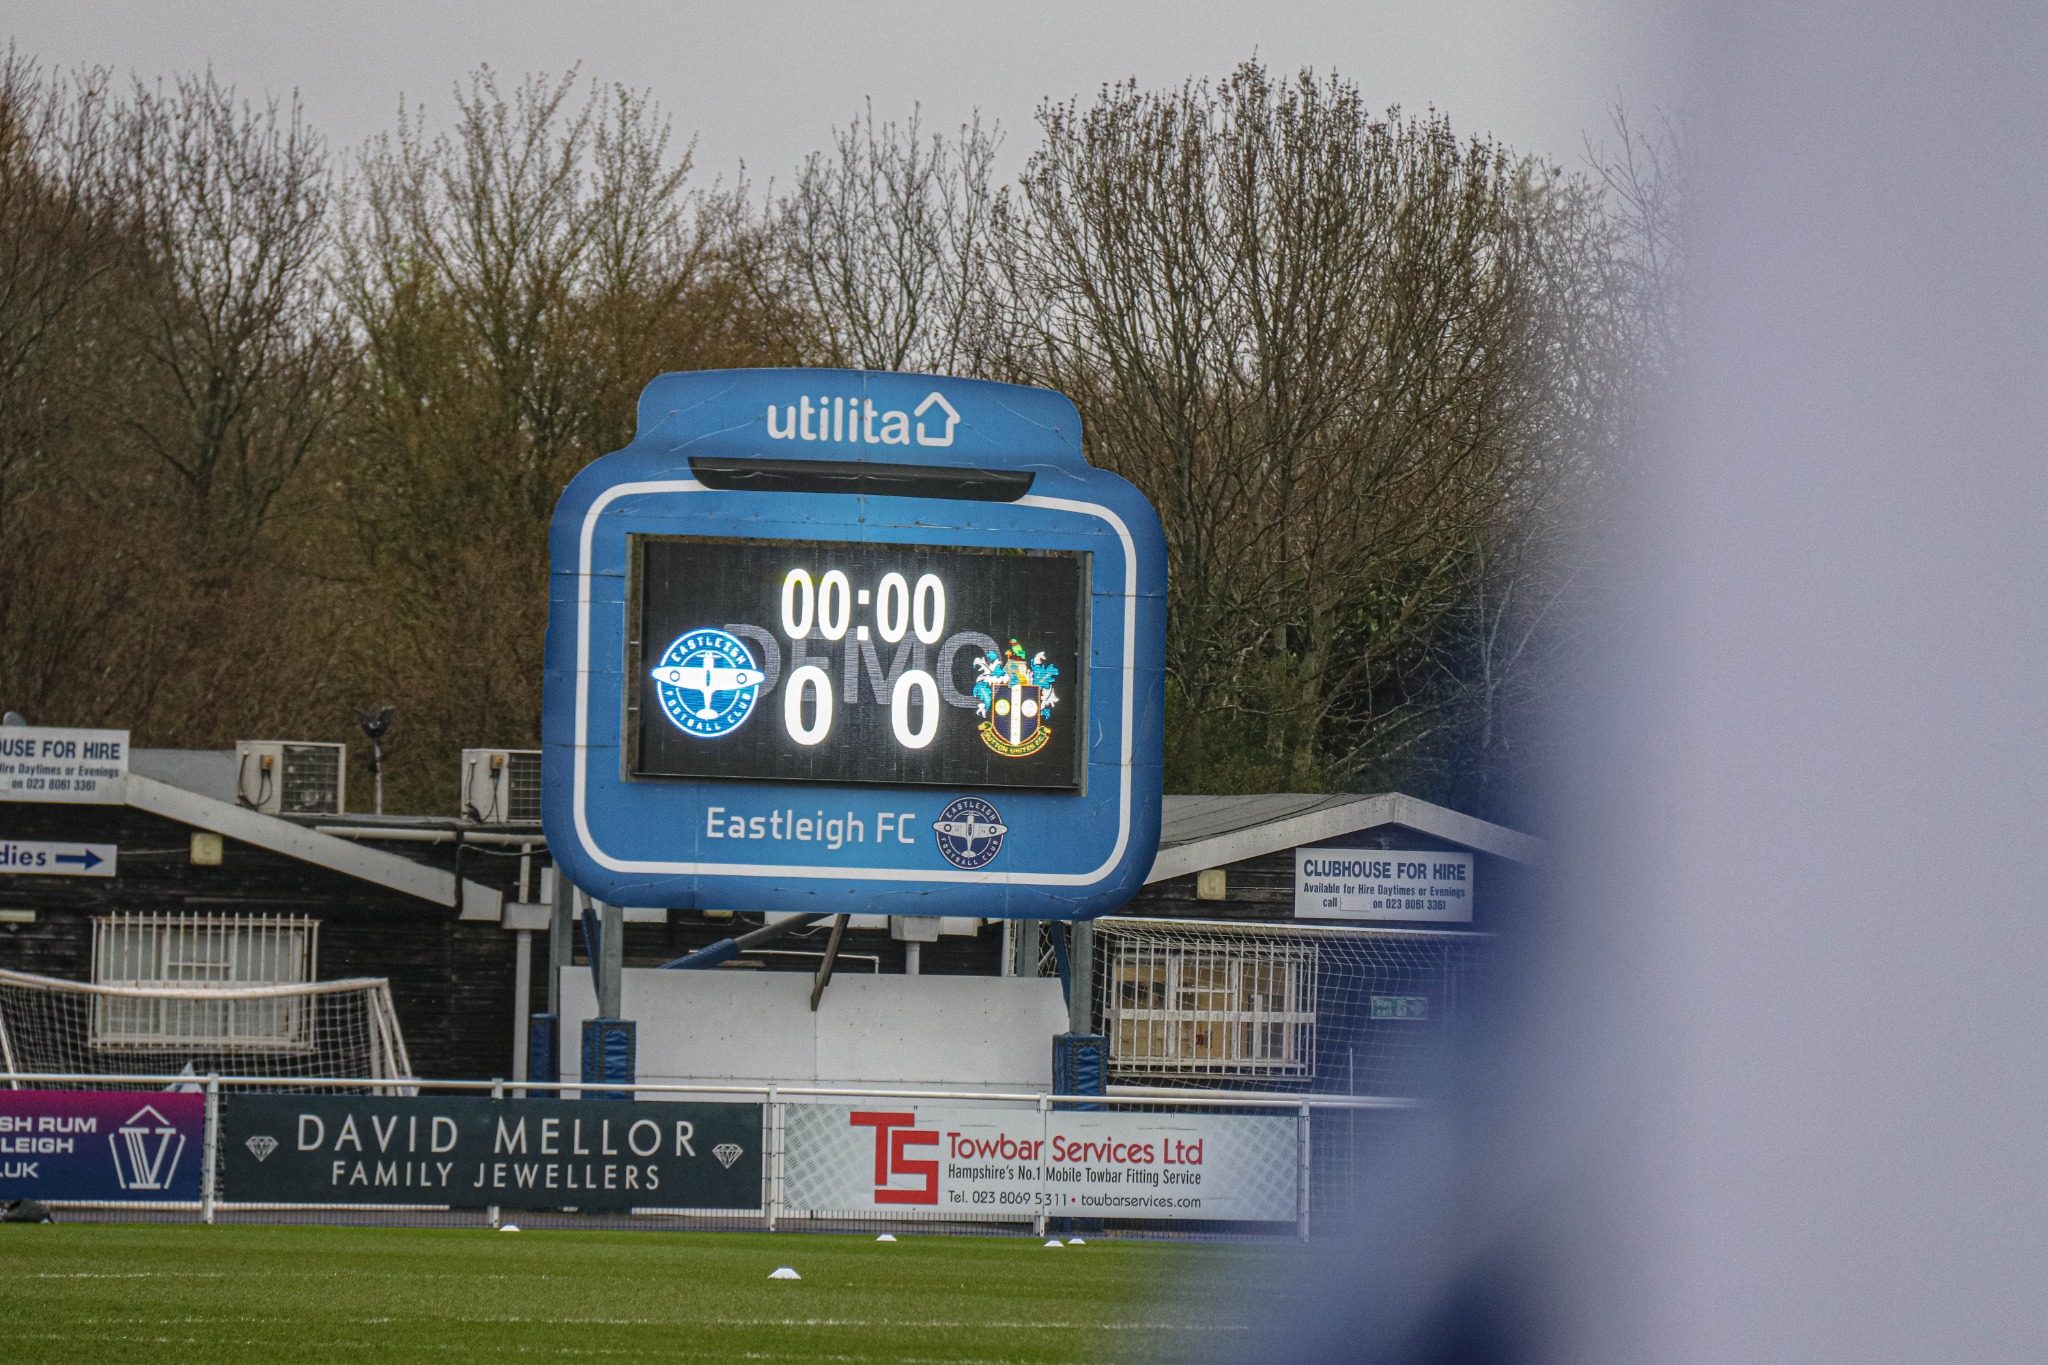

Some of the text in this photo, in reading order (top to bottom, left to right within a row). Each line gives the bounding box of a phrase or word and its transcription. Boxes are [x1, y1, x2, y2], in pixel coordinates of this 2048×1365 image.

[767, 395, 910, 445] utilita
[781, 568, 946, 645] 00:00
[671, 636, 746, 665] EASTLEIGH
[665, 690, 752, 731] FOOTBALL CLUB
[784, 665, 940, 749] 0 0
[42, 741, 76, 759] FOR
[83, 742, 120, 760] HIRE
[18, 763, 61, 776] Daytimes
[65, 767, 74, 775] or
[78, 766, 119, 779] Evenings
[11, 779, 96, 791] on 023 8061 3361
[946, 801, 997, 821] EASTLEIGH
[706, 806, 916, 850] Eastleigh FC
[941, 837, 999, 866] FOOTBALL CLUB
[1303, 859, 1466, 881] CLUBHOUSE FOR HIRE
[1303, 882, 1466, 899] Available for Hire Daytimes or Evenings
[1322, 897, 1446, 910] call on 023 8061 3361
[38, 1116, 97, 1133] RUM
[297, 1114, 697, 1158] DAVID MELLOR
[947, 1132, 1203, 1165] Towbar Services Ltd
[332, 1160, 660, 1191] FAMILY JEWELLERS
[948, 1163, 1201, 1187] Hampshire's No.1 Mobile Towbar Fitting Service
[948, 1190, 1201, 1208] Tel. 023 8069 5311 towbarservices.com
